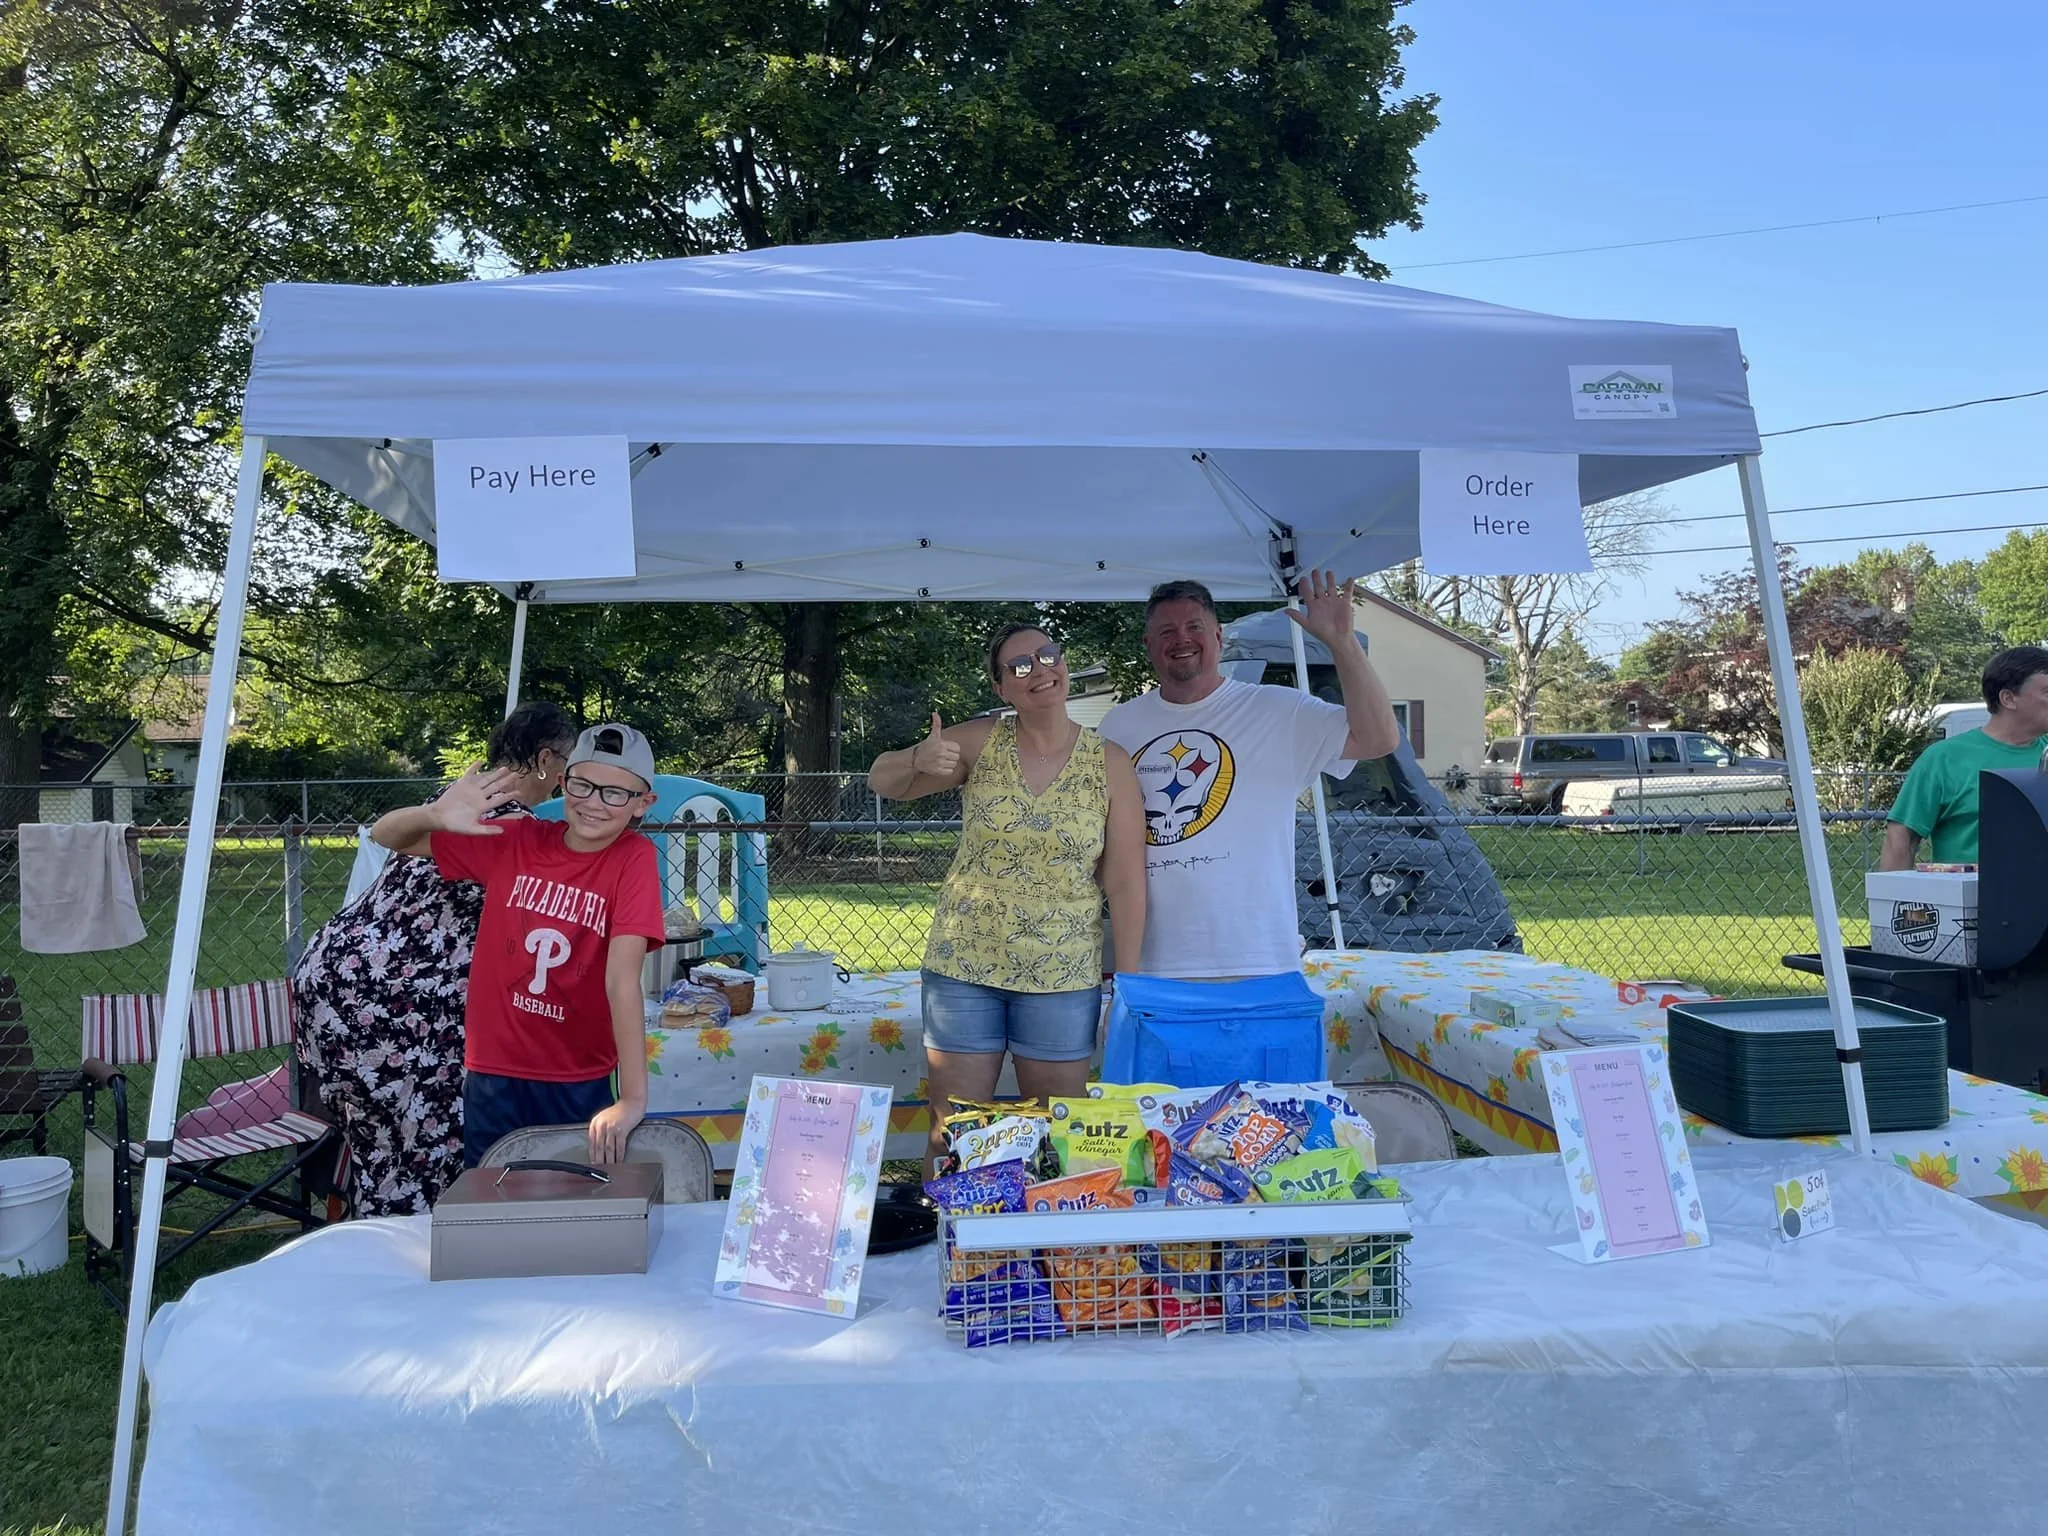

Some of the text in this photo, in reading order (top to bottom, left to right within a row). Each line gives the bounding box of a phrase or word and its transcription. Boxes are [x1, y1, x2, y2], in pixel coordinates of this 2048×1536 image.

[1582, 382, 1662, 393] CARAVAN
[470, 464, 596, 493] Pay Here
[1466, 475, 1534, 497] Order
[1473, 515, 1530, 535] Here
[512, 992, 565, 1020] BASEBALL
[1594, 1062, 1618, 1072] MENU
[804, 1095, 832, 1106] MENU
[1086, 1121, 1129, 1139] utz
[1234, 1118, 1261, 1149] POP
[1076, 1144, 1124, 1157] Vinegar
[1240, 1121, 1281, 1163] CORN
[1296, 1168, 1343, 1192] utz
